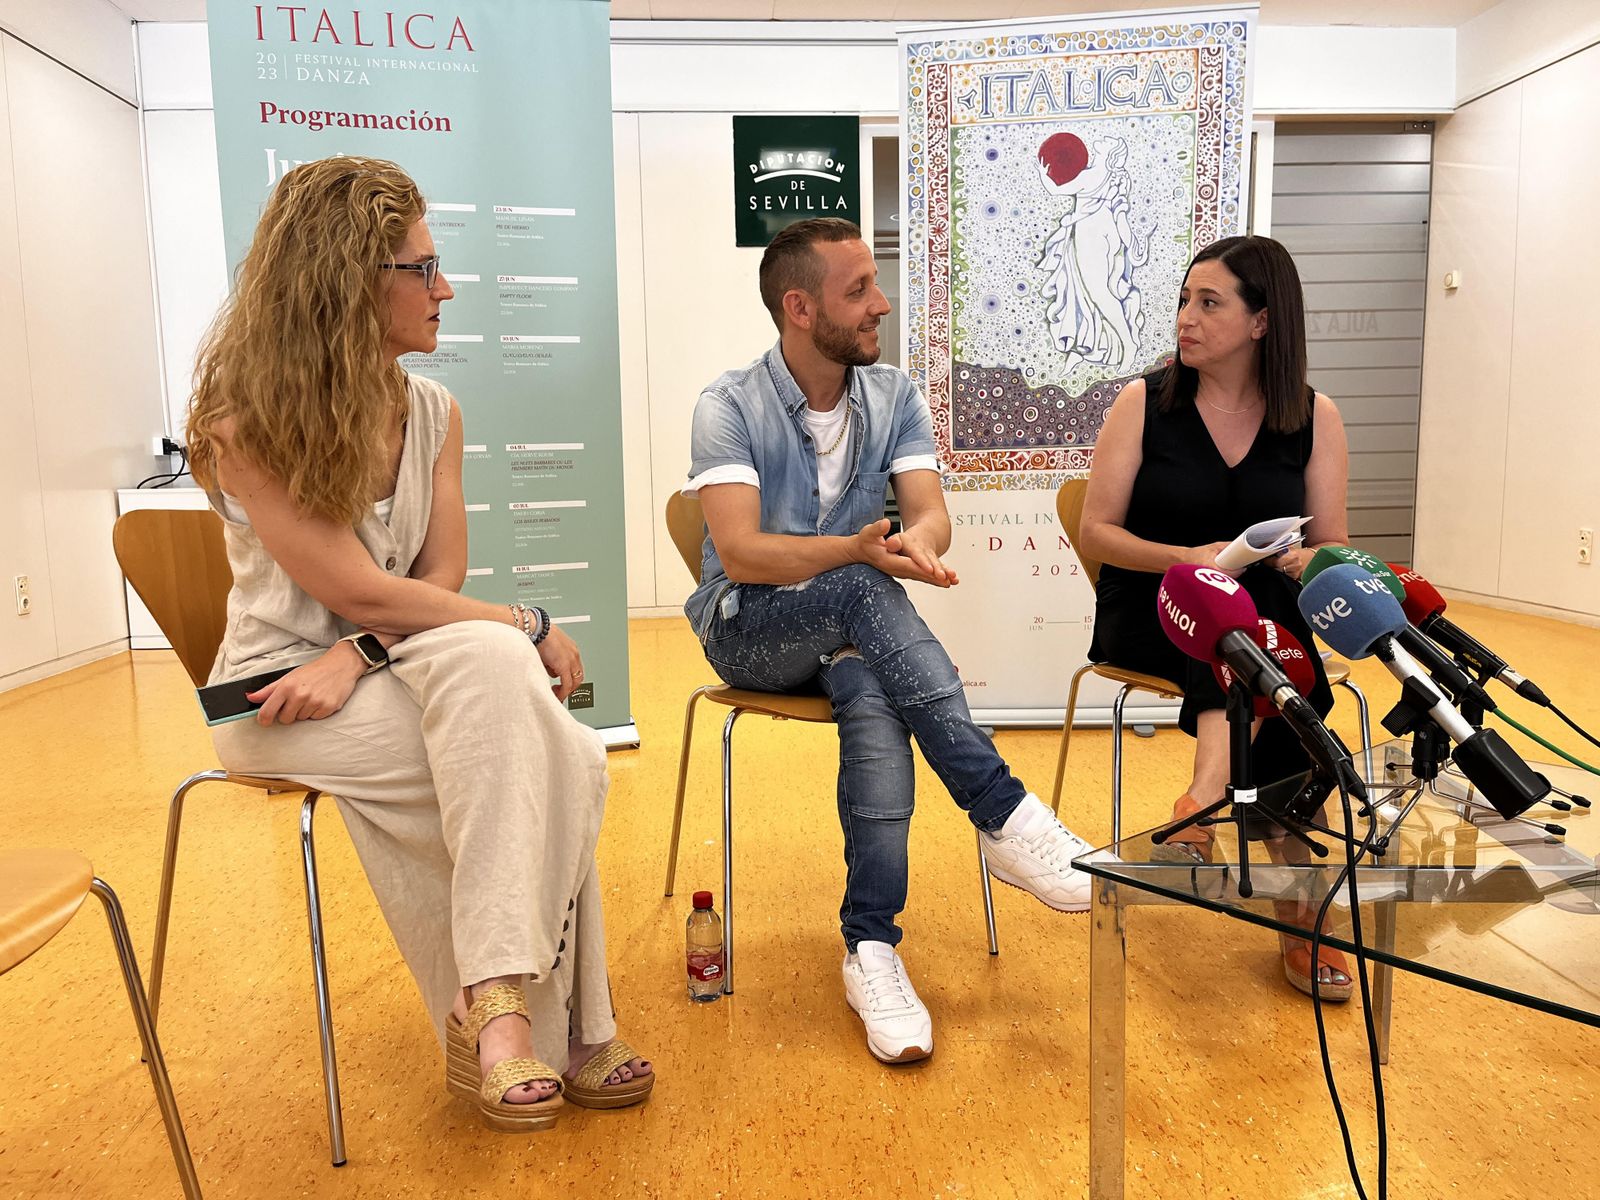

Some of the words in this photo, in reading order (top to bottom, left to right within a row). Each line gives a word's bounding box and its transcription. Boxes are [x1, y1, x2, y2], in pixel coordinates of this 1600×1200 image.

[254, 5, 476, 52] ITALICA
[256, 52, 277, 64] 20
[295, 54, 361, 67] FESTIVAL
[367, 58, 479, 73] INTERNACIONAL
[257, 67, 278, 80] 23
[297, 67, 370, 85] DANZA
[978, 60, 1179, 119] ITALICA
[259, 101, 453, 132] Programación
[790, 180, 806, 190] DE
[749, 195, 848, 210] SEVILLA
[956, 513, 1024, 526] STIVAL
[988, 535, 1071, 551] DAN
[1032, 564, 1078, 576] 202
[1354, 579, 1392, 595] tve
[1033, 616, 1044, 624] 20
[1084, 615, 1093, 623] 15
[1311, 597, 1352, 630] tve
[1275, 647, 1304, 661] iete
